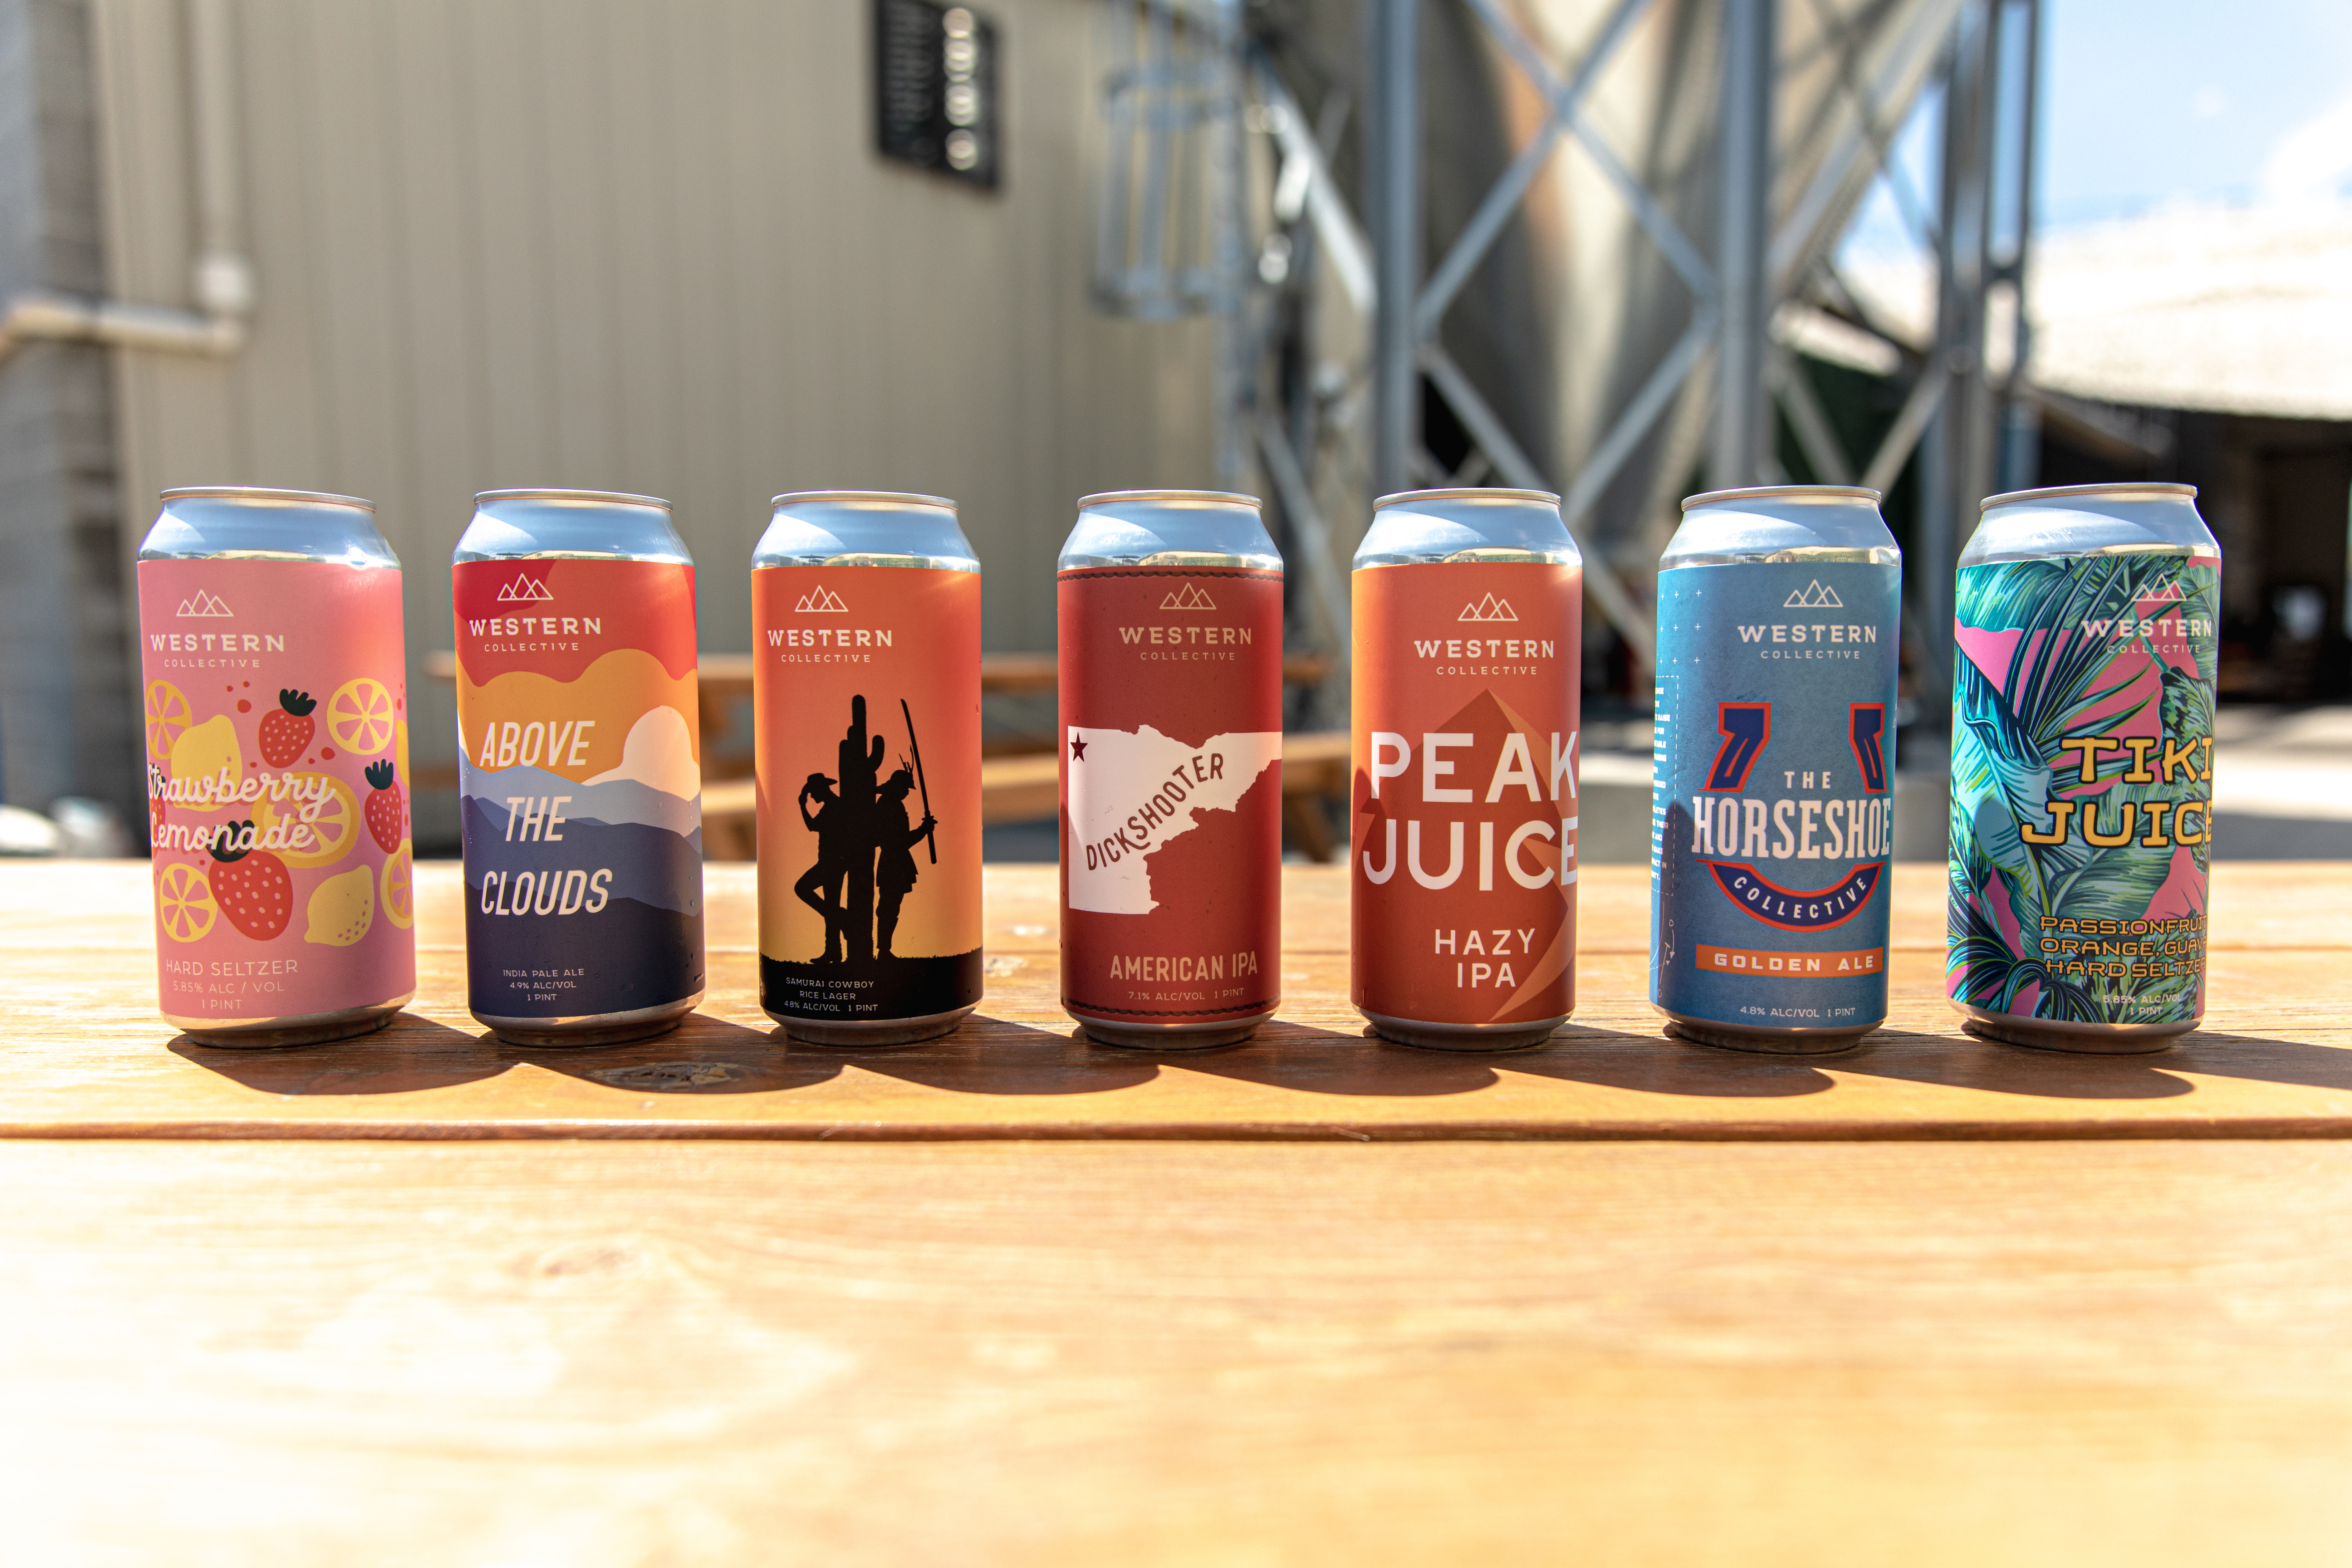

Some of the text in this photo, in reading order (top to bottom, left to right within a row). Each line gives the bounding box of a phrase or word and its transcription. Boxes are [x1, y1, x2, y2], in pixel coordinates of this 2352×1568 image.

[469, 618, 601, 637] WESTERN
[1119, 627, 1251, 645] WESTERN
[1738, 625, 1876, 643] WESTERN
[2081, 619, 2211, 637] WESTERN
[150, 634, 284, 652] WESTERN
[768, 629, 892, 647] WESTERN
[484, 643, 579, 652] COLLECTIVE
[1140, 652, 1235, 660] COLLECTIVE
[1414, 640, 1554, 658] WESTERN
[1760, 651, 1860, 659] COLLECTIVE
[2107, 645, 2200, 653] COLLECTIVE
[164, 659, 260, 668] COLLECTIVE
[781, 655, 871, 663] COLLECTIVE
[1436, 666, 1537, 675] COLLECTIVE
[479, 720, 596, 767] ABOVE
[1371, 731, 1577, 803] PEAK
[2059, 735, 2213, 785] TIKI
[1784, 771, 1831, 789] THE
[148, 764, 337, 823] Strawberry
[505, 796, 572, 842] THE
[1086, 753, 1224, 871] DICKSHOOTER
[151, 812, 316, 851] Lemonade
[1691, 797, 1891, 859] HORSESHOE
[2019, 799, 2212, 849] JUICE
[1363, 816, 1578, 891] JUICE
[481, 868, 613, 916] CLOUDS
[1734, 876, 1866, 918] COLLECTIVE
[2040, 915, 2207, 935] PASSIONFRUIT
[1435, 928, 1535, 955] HAZY
[2040, 936, 2207, 957] ORANGE, GUAVA
[166, 959, 298, 976] HARD SELTZER
[1110, 950, 1258, 981] AMERICAN IPA
[1714, 953, 1873, 971] GOLDEN ALE
[2046, 957, 2206, 977] HARD SELTZER
[786, 977, 824, 988] SAMURAI
[1457, 962, 1516, 988] IPA
[173, 981, 285, 994] 5.85% ALC / VOL
[533, 981, 577, 990] ALC/VOL
[800, 990, 819, 999] RICE
[1129, 991, 1150, 1000] 7.1%
[1155, 991, 1205, 1001] ALC/VOL
[1223, 988, 1244, 998] PINT
[211, 999, 242, 1010] PINT
[803, 1003, 841, 1011] ALC/VOL
[2103, 994, 2182, 1004] 5.85% ALC/VOL
[1740, 1007, 1856, 1018] 4.8% ALC/VOL 1 PINT
[2138, 1006, 2163, 1015] PINT
